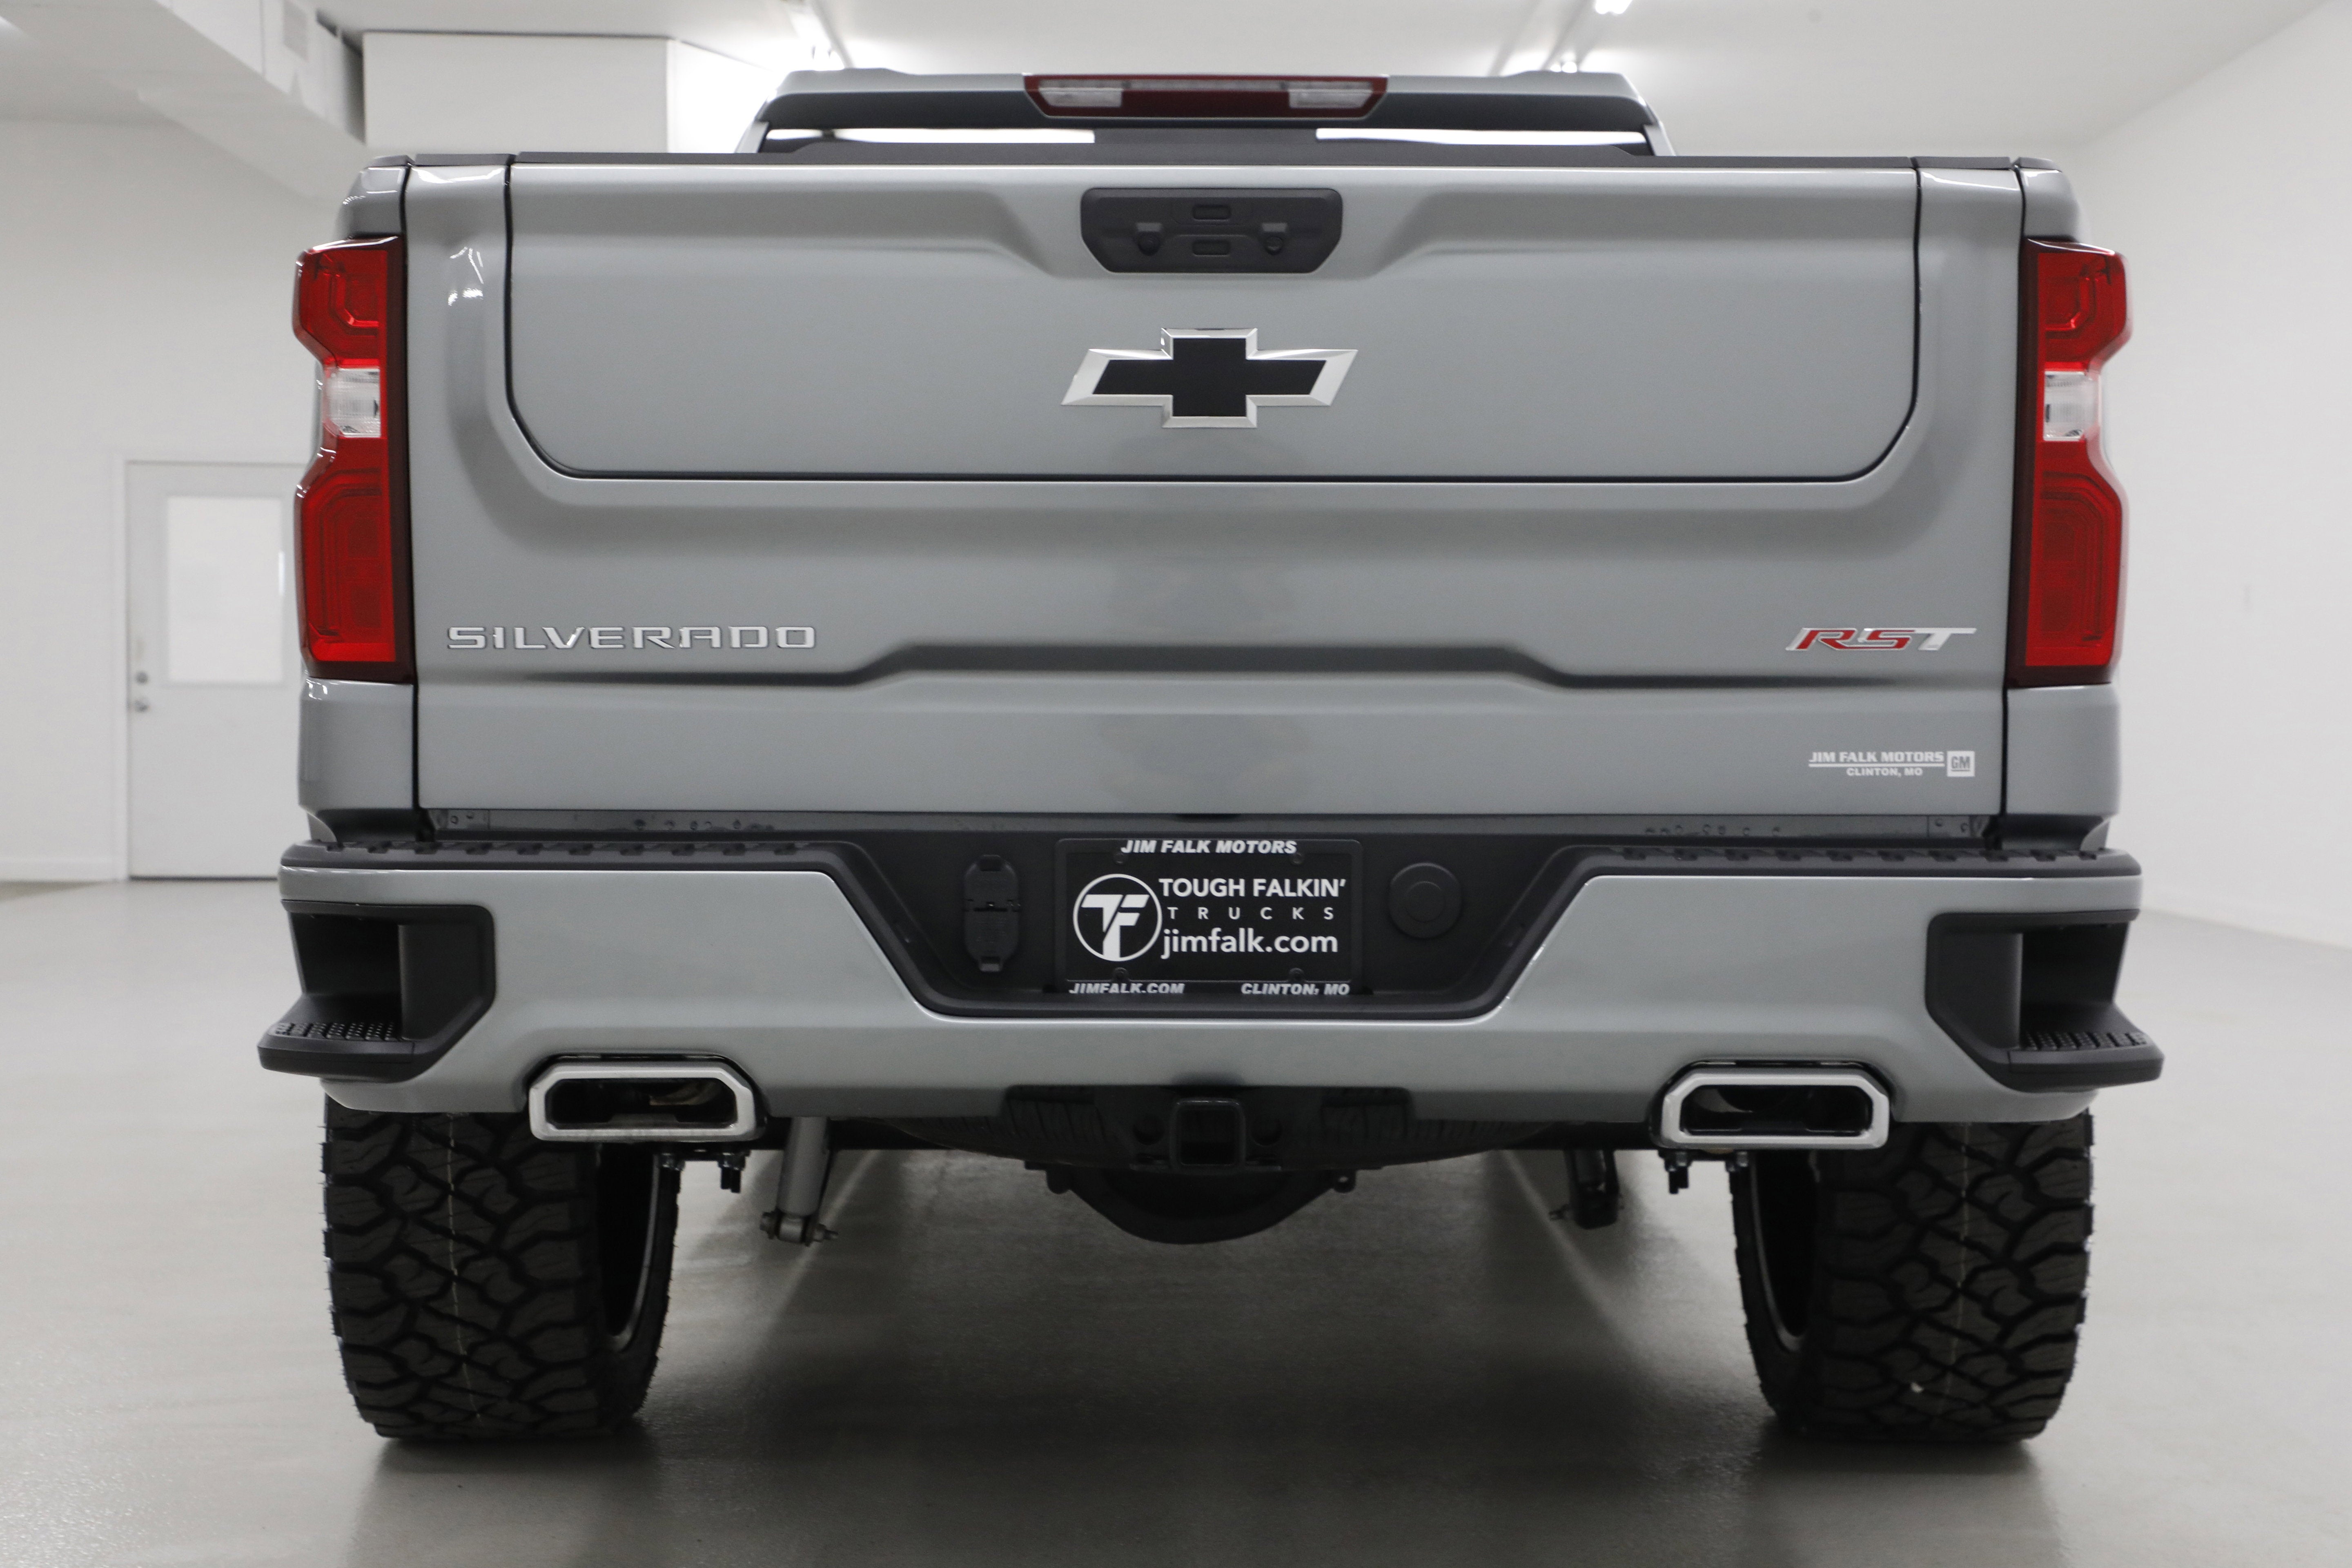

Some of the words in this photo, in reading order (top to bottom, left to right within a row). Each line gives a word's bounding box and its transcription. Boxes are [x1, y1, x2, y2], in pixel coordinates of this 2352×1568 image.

[447, 626, 815, 649] SILVERADO
[1785, 627, 1977, 650] RST
[1809, 752, 1835, 762] JIM
[1839, 752, 1877, 762] FALK
[1880, 752, 1944, 762] MOTORS
[1951, 756, 1970, 769] GM
[1846, 768, 1902, 777] CLINTON,
[1904, 768, 1923, 776] MO
[1120, 840, 1156, 853] JIM
[1161, 840, 1210, 853] FALK
[1215, 840, 1297, 854] MOTORS
[1159, 878, 1245, 897] TOUGH
[1168, 907, 1334, 920] TRUCKS
[1161, 928, 1338, 960] jimfalk.com
[1069, 983, 1185, 994] JIMFALK.COM
[1241, 983, 1320, 995] CLINTON,
[1324, 984, 1350, 995] MO
